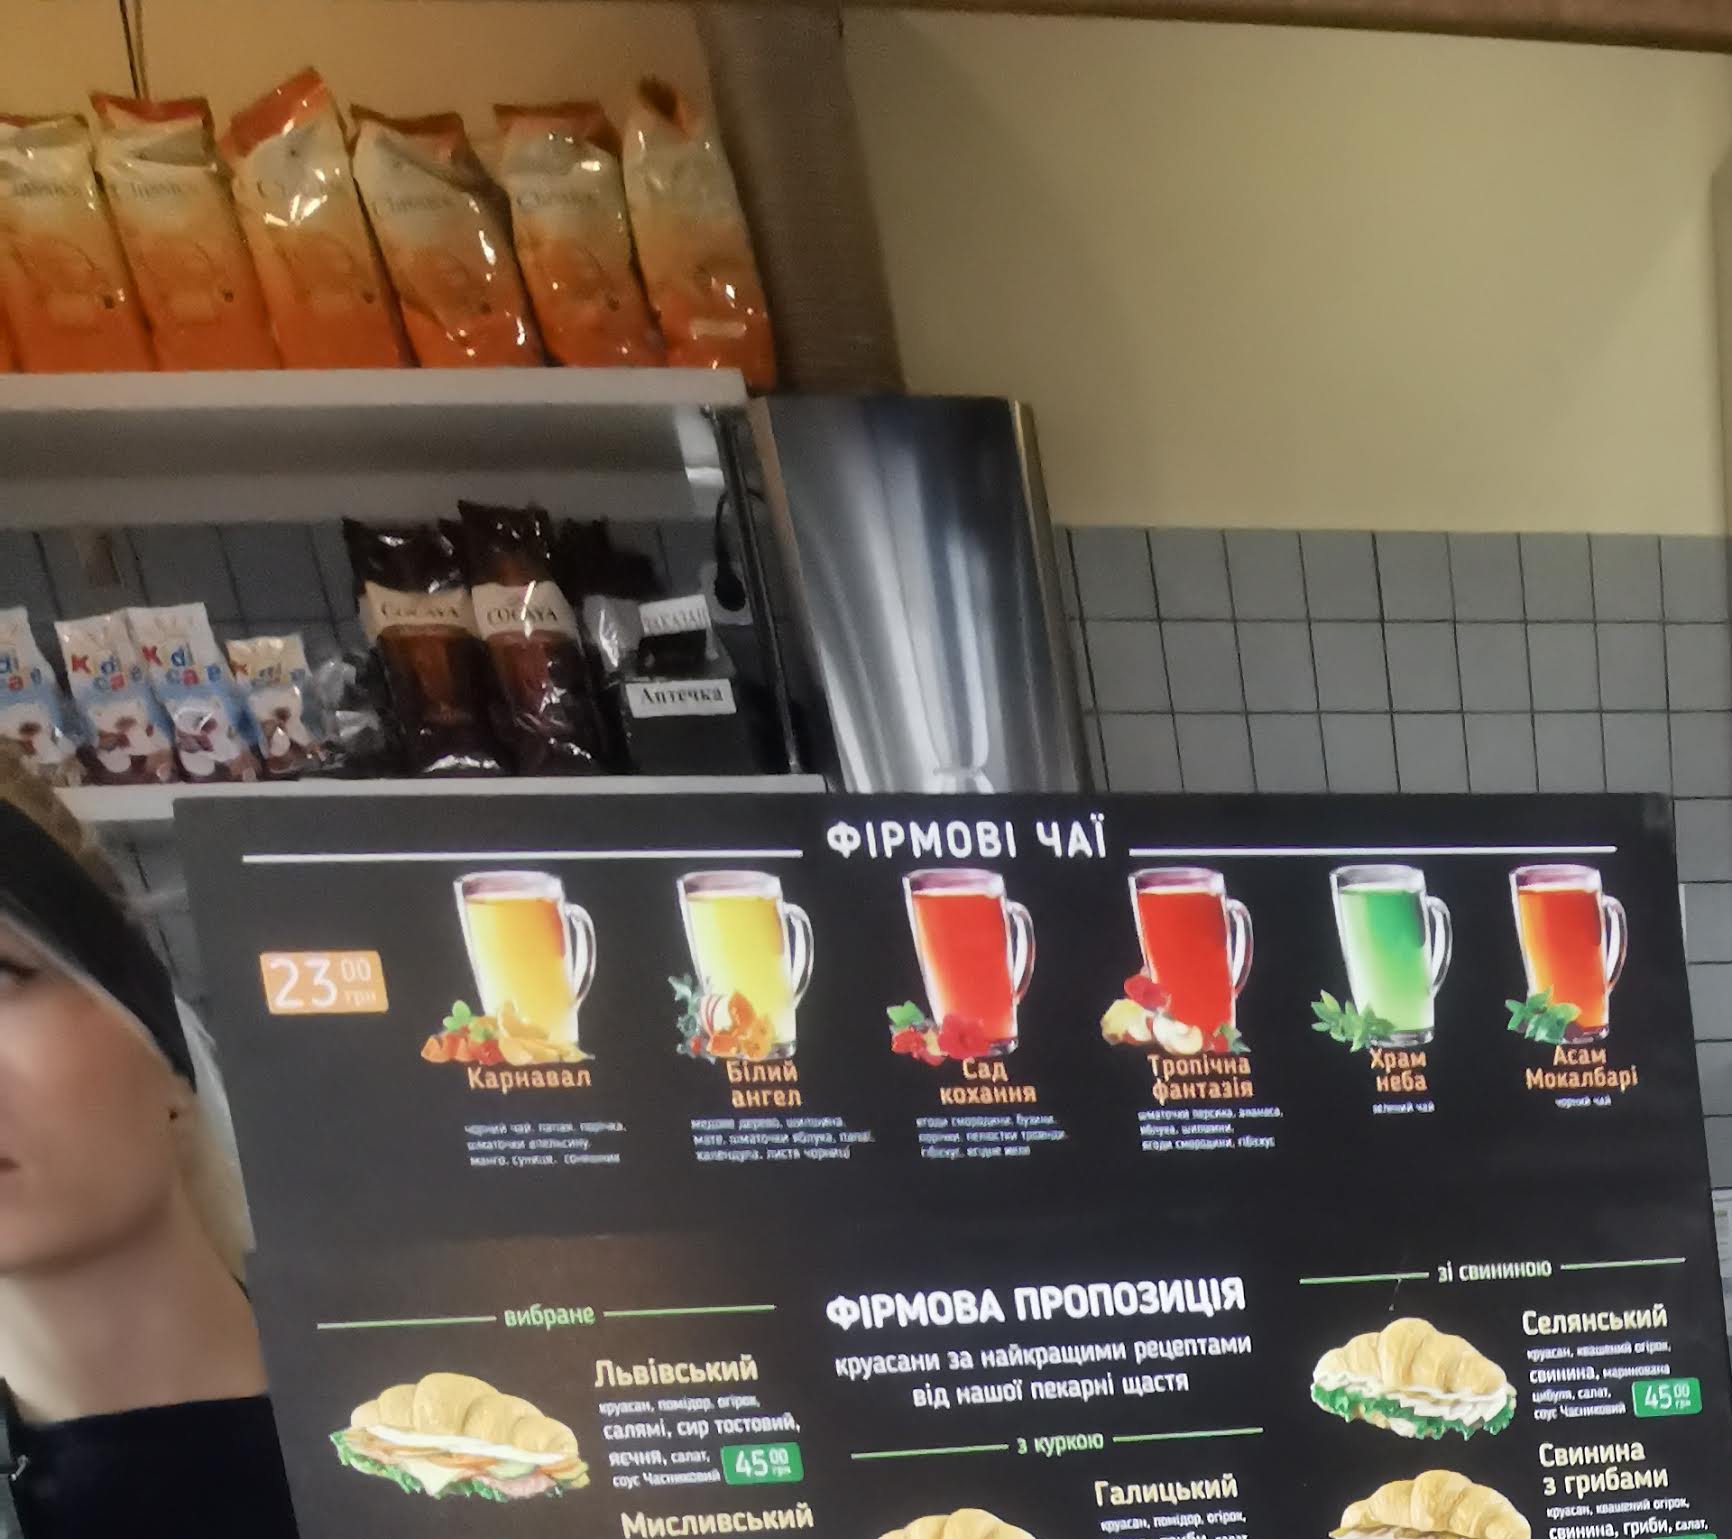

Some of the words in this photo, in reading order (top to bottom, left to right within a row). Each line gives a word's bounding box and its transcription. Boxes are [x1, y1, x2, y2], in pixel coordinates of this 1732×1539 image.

[640, 684, 725, 705] Аптечка
[826, 819, 1017, 859] ФІРМОВІ
[1035, 811, 1107, 859] ЧАЇ
[268, 957, 338, 1009] 23
[1147, 1053, 1252, 1079] Тропічна
[1369, 1047, 1428, 1074] Храм
[1551, 1044, 1609, 1068] Асам
[467, 1066, 593, 1094] Карнавал
[725, 1058, 800, 1084] Білий
[961, 1058, 1010, 1084] Сад
[1375, 1071, 1429, 1094] неба
[1524, 1063, 1640, 1093] Мокалбарі
[730, 1086, 803, 1109] ангел
[938, 1083, 1038, 1107] кохання
[1150, 1077, 1256, 1106] фантазія
[1437, 1260, 1455, 1284] зі
[1458, 1260, 1553, 1284] свининою
[503, 1303, 597, 1330] вибране
[825, 1287, 1006, 1332] ФІРМОВА
[1013, 1276, 1247, 1323] ПРОПОЗИЦІЯ
[1521, 1302, 1670, 1337] Селянський
[594, 1353, 760, 1389] Львівський
[834, 1348, 941, 1382] круасани
[946, 1349, 975, 1371] за
[980, 1339, 1127, 1370] найкращими
[1133, 1334, 1254, 1365] рецептами
[911, 1382, 951, 1411] від
[955, 1379, 1024, 1406] нашої
[1029, 1371, 1116, 1403] пекарні
[1121, 1370, 1191, 1398] щастя
[676, 1418, 710, 1442] сир
[1032, 1432, 1105, 1459] куркою
[1538, 1440, 1647, 1470] Свинина
[734, 1449, 769, 1479] 45
[1093, 1471, 1240, 1509] Галицький
[1564, 1465, 1670, 1500] грибами
